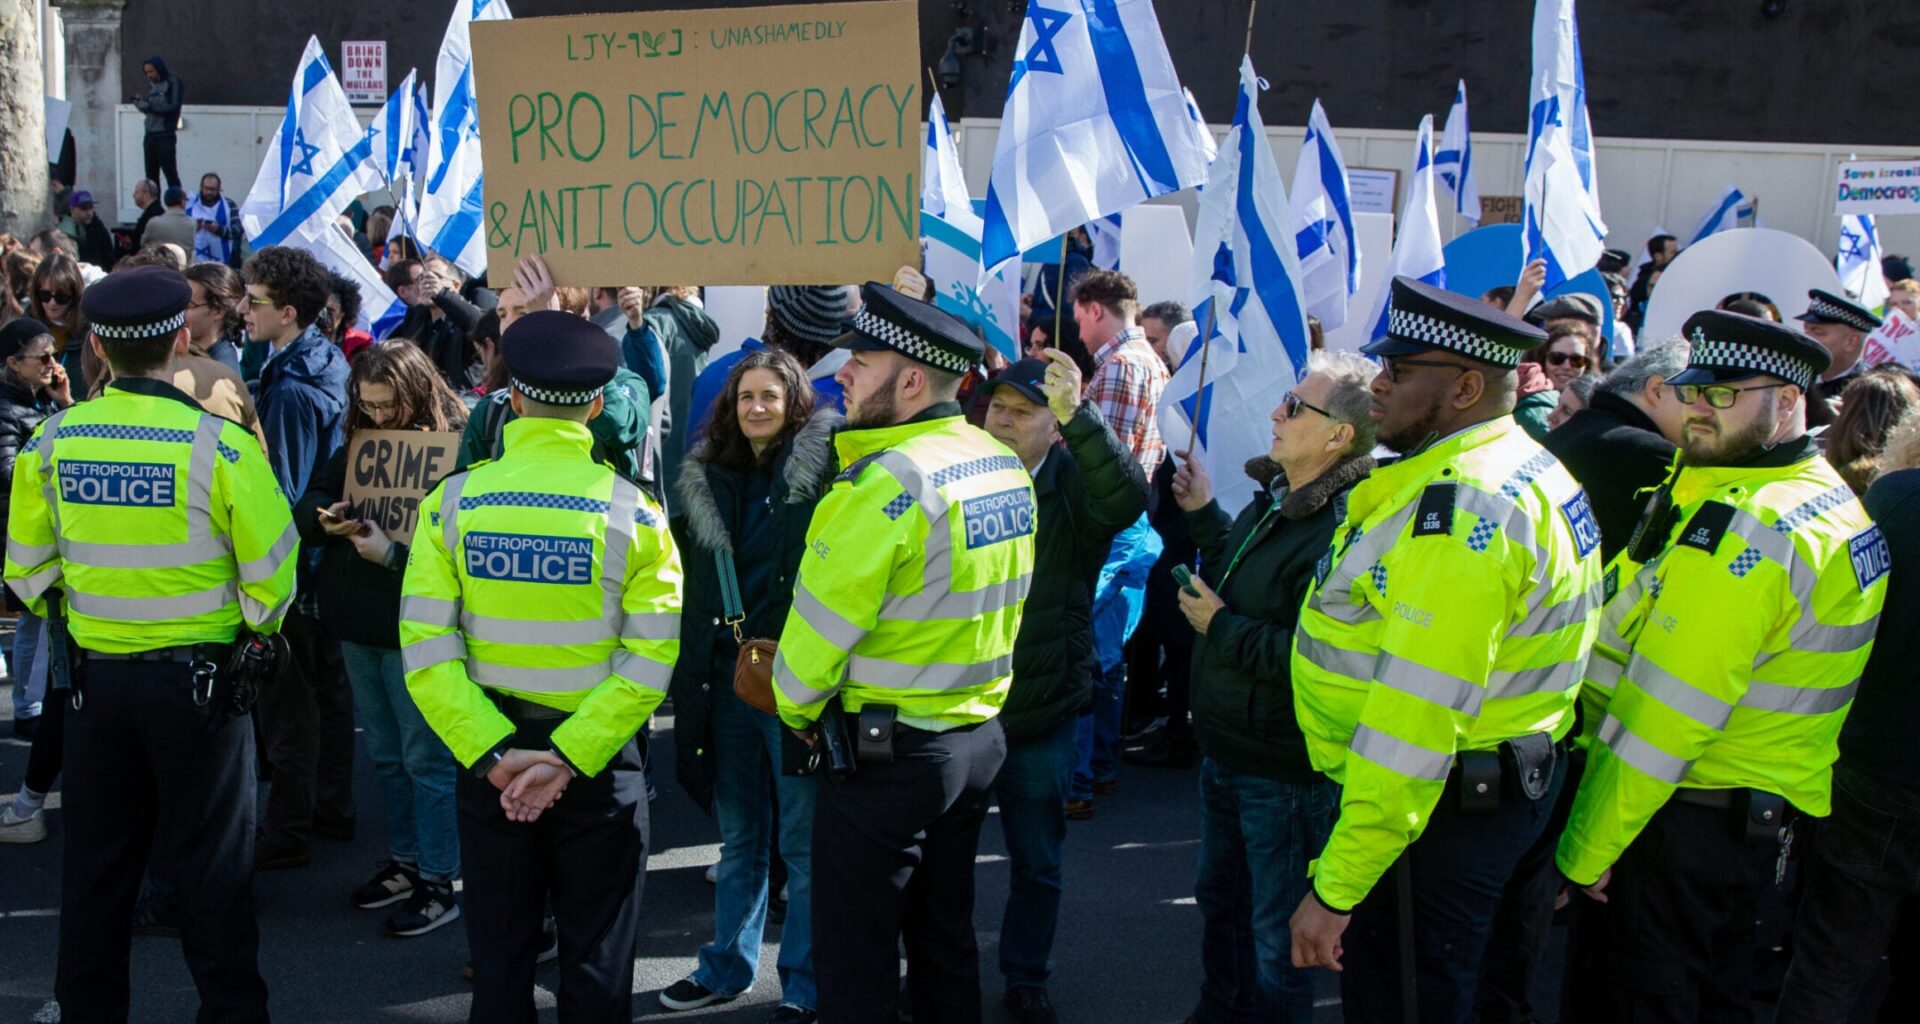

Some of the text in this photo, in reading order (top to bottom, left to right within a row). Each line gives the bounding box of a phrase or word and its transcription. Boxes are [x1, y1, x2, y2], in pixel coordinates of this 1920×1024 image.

[710, 20, 847, 49] UNASHAMEDLY
[347, 46, 382, 57] BRING
[348, 57, 382, 68] DOWN
[356, 70, 372, 79] THE
[508, 83, 916, 164] PRO DEMOCRACY
[1843, 168, 1875, 179] Save
[622, 172, 916, 247] OCCUPATION
[59, 462, 173, 479] METROPOLITAN
[354, 439, 446, 490] CRIME
[61, 476, 172, 504] POLICE
[967, 505, 1034, 545] POLICE
[1426, 512, 1439, 521] CE
[465, 535, 592, 554] METROPOLITAN
[1697, 527, 1710, 537] CE
[467, 550, 589, 581] POLICE
[1854, 540, 1890, 582] POLICE
[1393, 601, 1435, 628] POLICE
